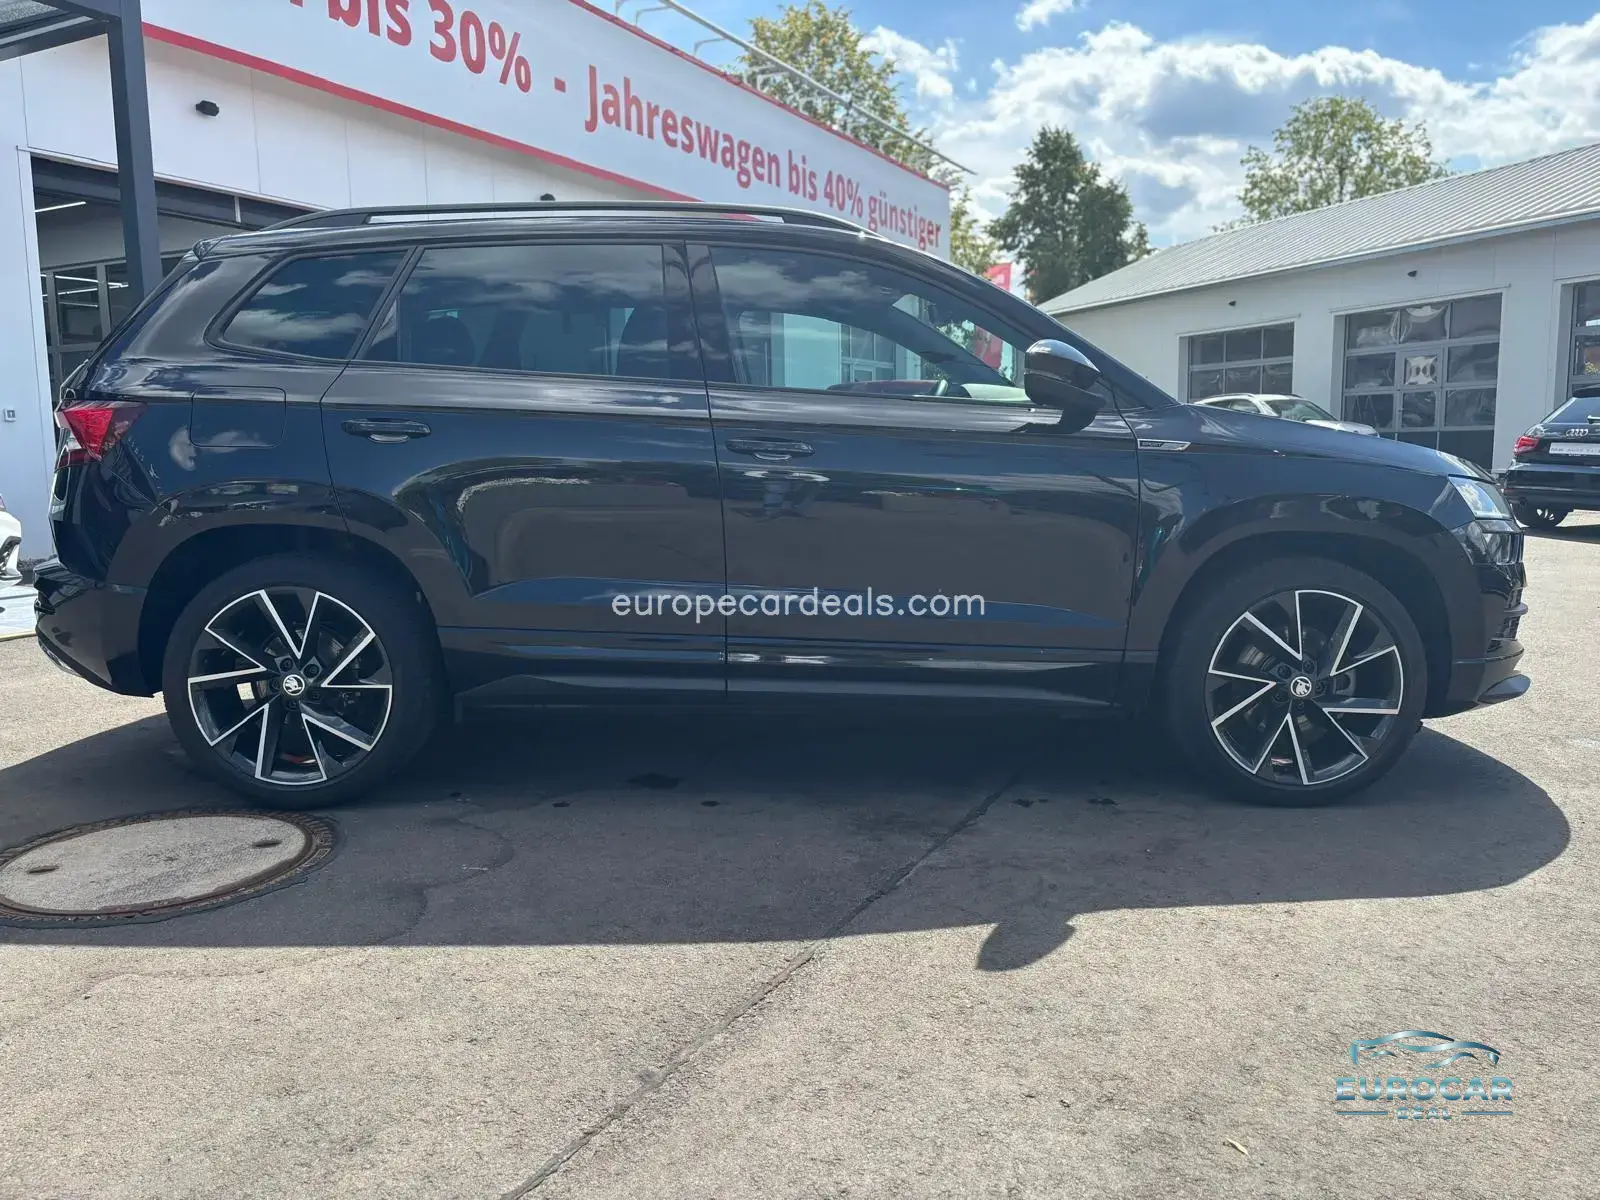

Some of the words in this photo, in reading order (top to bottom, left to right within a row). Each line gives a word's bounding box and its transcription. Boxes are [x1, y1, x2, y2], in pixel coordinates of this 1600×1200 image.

[429, 0, 532, 93] 30%
[584, 64, 780, 188] Jahreswagen
[787, 150, 817, 201] bis
[823, 169, 863, 218] 40%
[868, 192, 941, 251] günstiger
